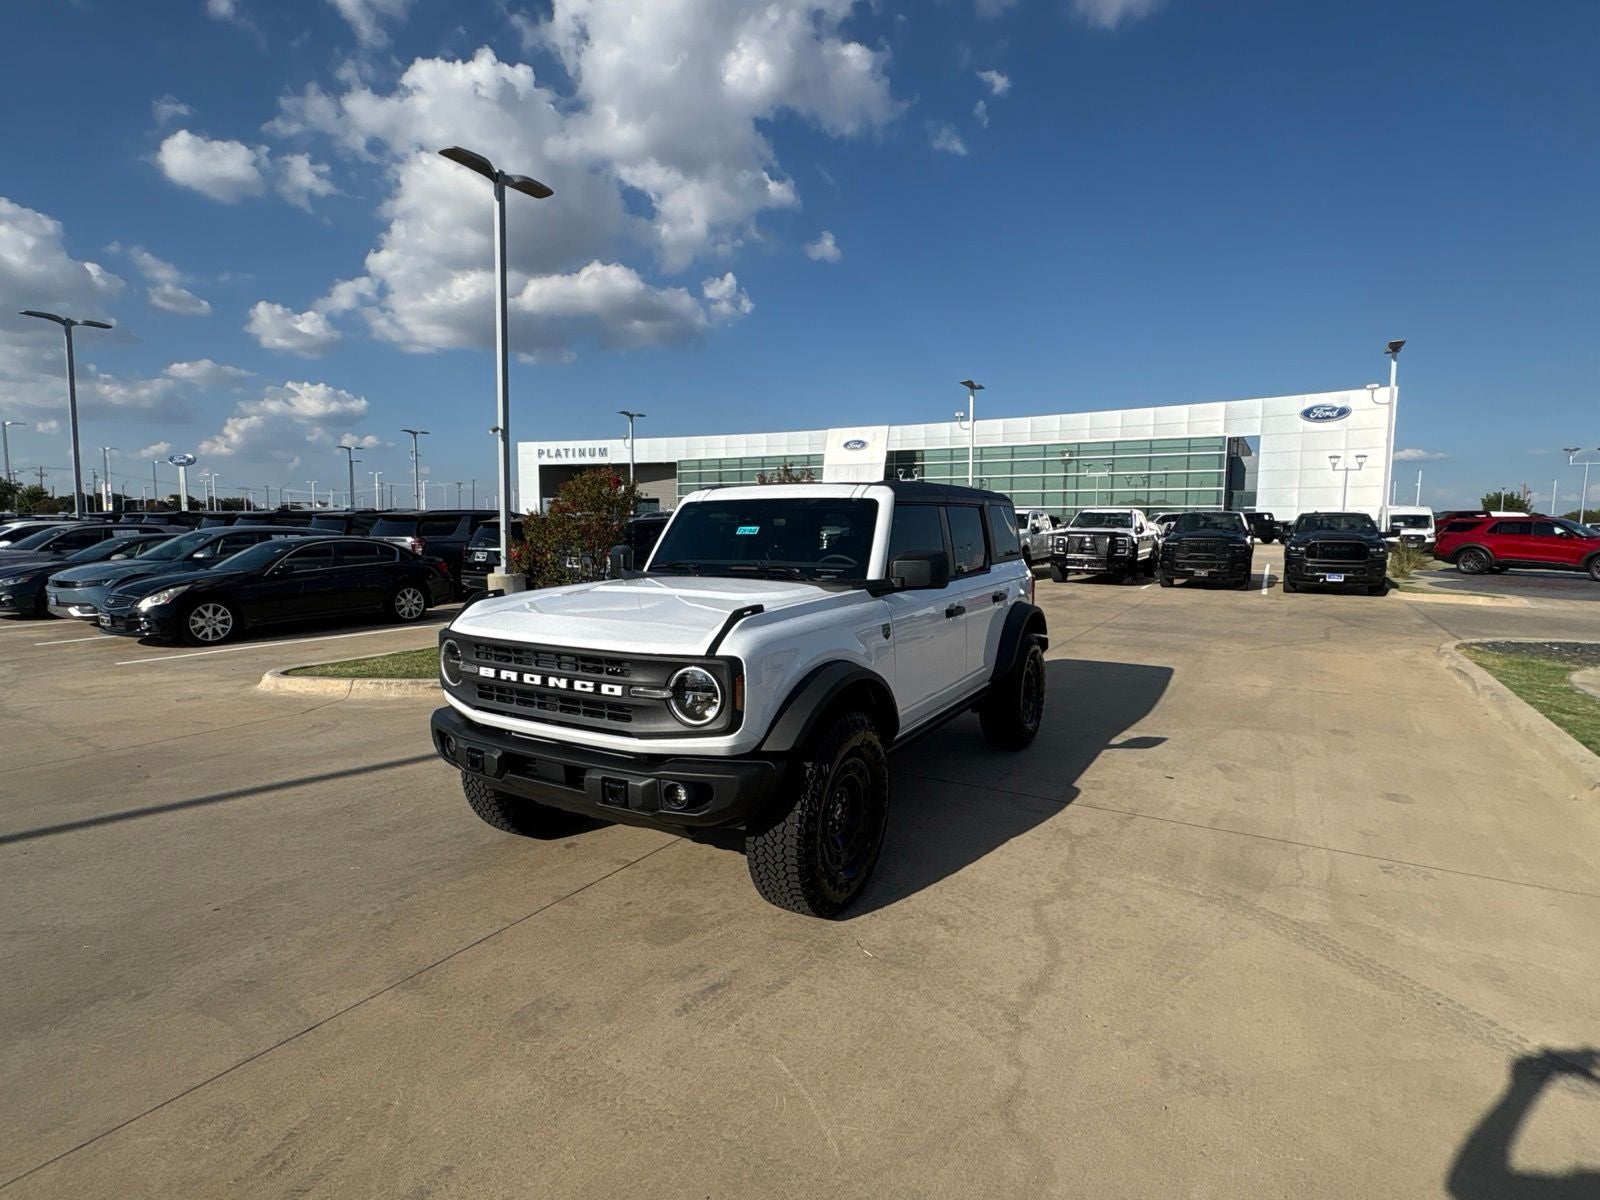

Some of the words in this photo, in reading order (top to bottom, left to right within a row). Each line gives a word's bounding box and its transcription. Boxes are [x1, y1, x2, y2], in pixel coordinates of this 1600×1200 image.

[1310, 406, 1340, 418] Ford
[537, 447, 608, 459] PLATINUM
[479, 666, 623, 697] BRONCO
